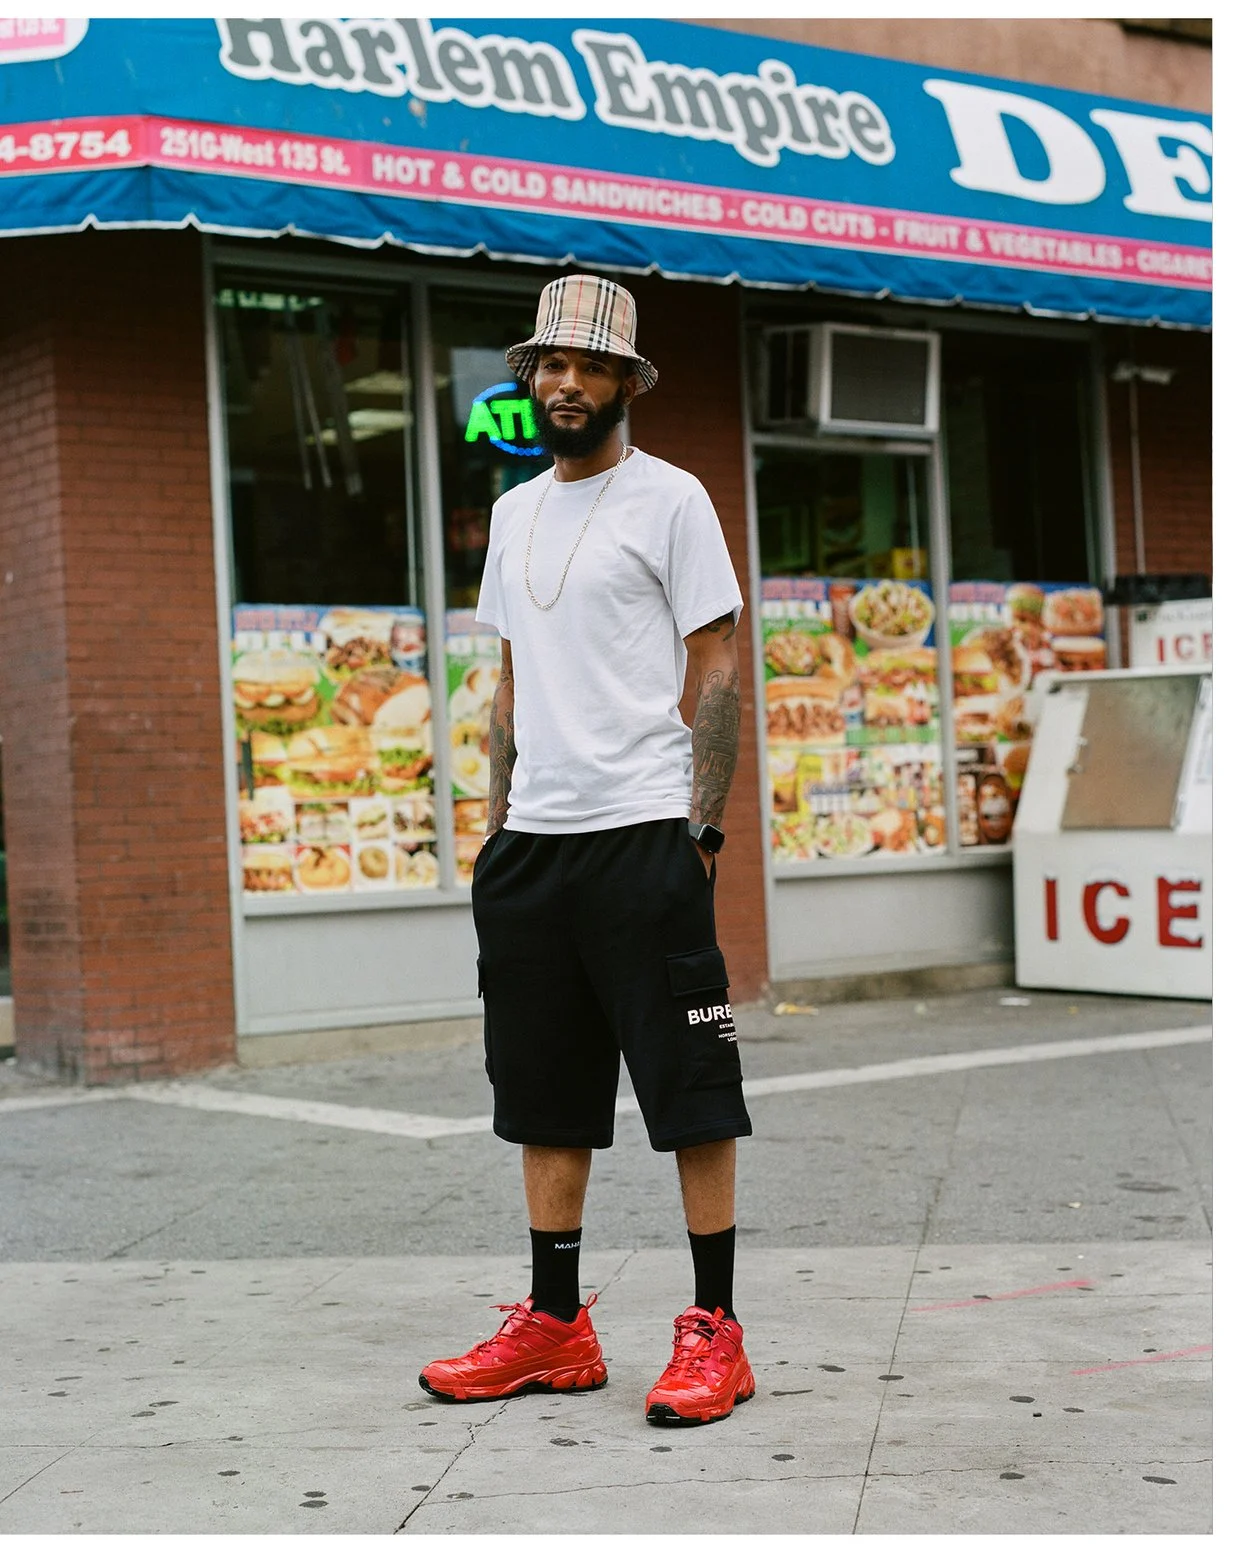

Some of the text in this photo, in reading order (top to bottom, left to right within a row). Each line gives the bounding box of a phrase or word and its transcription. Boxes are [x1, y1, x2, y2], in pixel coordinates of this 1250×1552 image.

[221, 18, 1212, 222] Harlem Empire DE
[279, 139, 318, 172] 135
[371, 152, 435, 187] HOT
[441, 161, 465, 190] &
[471, 165, 547, 200] COLD
[551, 175, 724, 222] SANDWICHES
[741, 199, 808, 231] COLD
[811, 208, 876, 240] CUTS
[893, 217, 962, 250] FRUIT
[965, 226, 984, 253] &
[985, 228, 1123, 270] VEGETABLES
[1044, 875, 1204, 949] ICE
